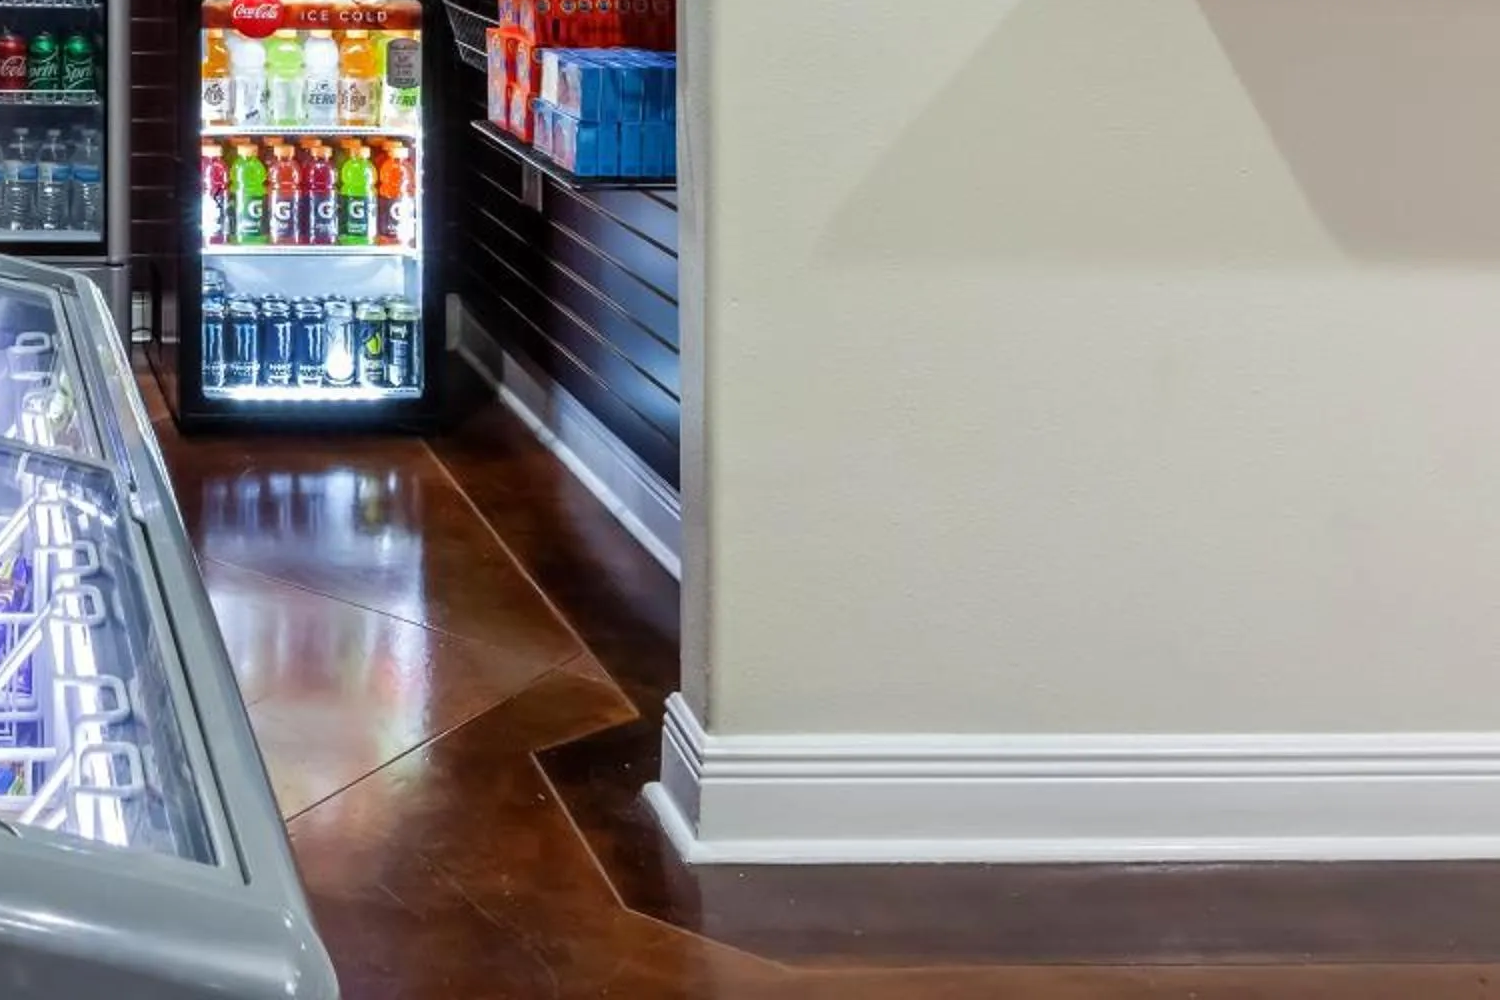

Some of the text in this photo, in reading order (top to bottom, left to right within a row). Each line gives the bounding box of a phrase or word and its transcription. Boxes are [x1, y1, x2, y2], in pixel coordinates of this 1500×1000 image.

[232, 3, 388, 23] Coca-Cola ICE COLD
[275, 201, 291, 220] G
[317, 201, 334, 219] G
[350, 201, 366, 218] G
